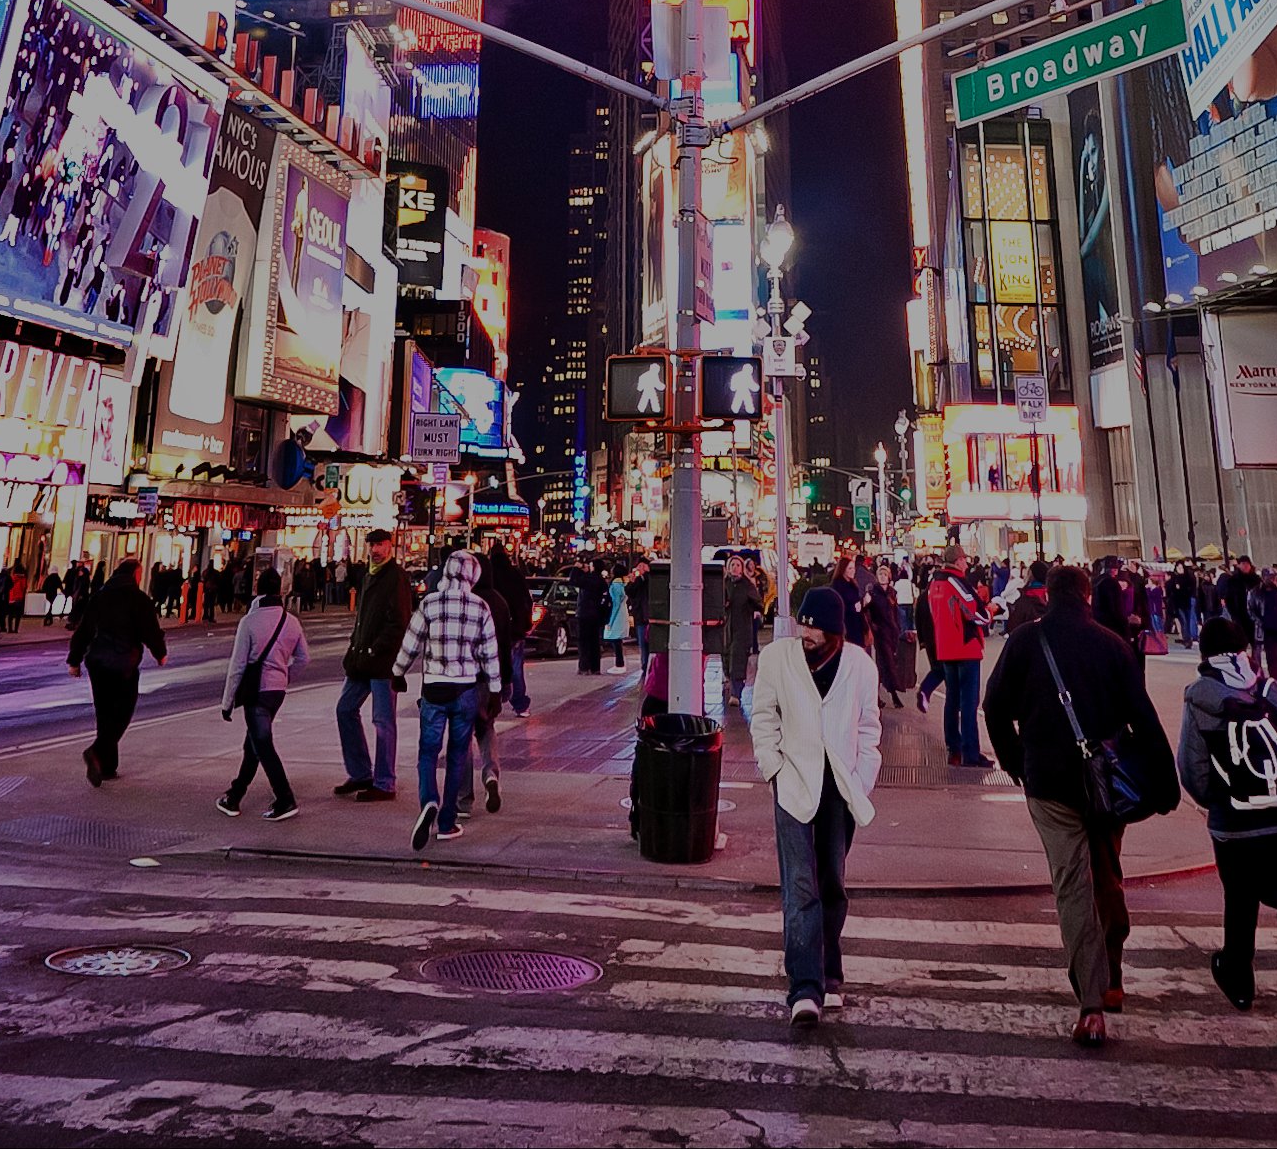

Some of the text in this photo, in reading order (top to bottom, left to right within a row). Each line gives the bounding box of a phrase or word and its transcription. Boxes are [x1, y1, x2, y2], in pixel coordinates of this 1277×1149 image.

[1181, 2, 1228, 86] HALL
[985, 21, 1149, 102] Broadway
[214, 136, 267, 192] AMOUS
[308, 207, 343, 256] SEOUL
[1002, 238, 1023, 247] THE
[998, 253, 1028, 269] LION
[1000, 272, 1031, 292] KING
[1021, 400, 1044, 409] WALK
[416, 418, 459, 428] RIGHT LANE
[1023, 411, 1043, 420] BIKE
[423, 433, 449, 443] MUST
[414, 448, 457, 457] TURN RIGHT
[174, 500, 222, 528] PLANET
